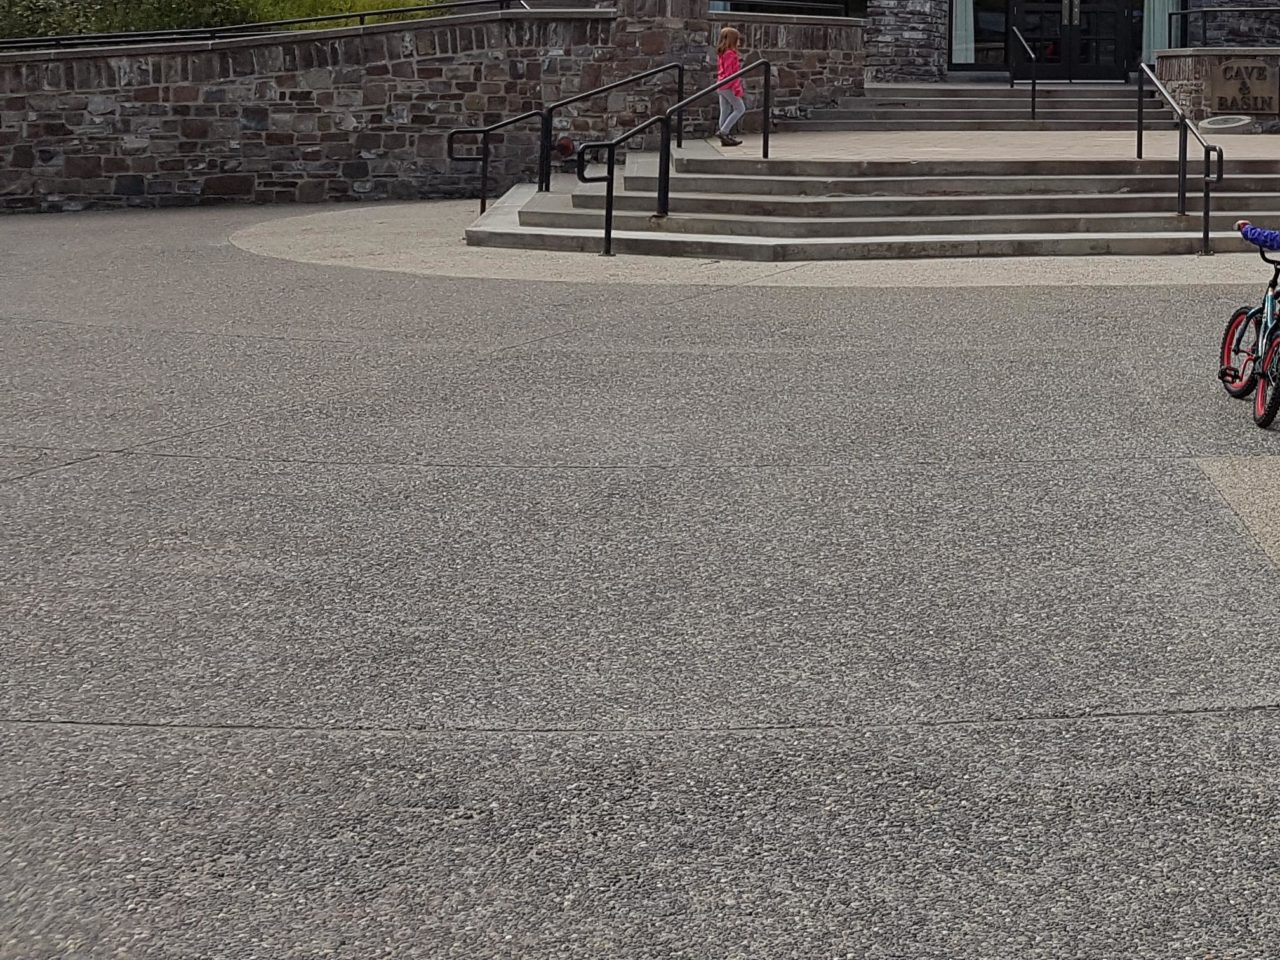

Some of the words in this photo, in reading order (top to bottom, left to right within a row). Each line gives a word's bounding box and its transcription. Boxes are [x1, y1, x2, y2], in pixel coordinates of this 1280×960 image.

[1222, 66, 1267, 81] CAVE
[1238, 81, 1251, 95] &
[1217, 96, 1273, 111] BASIN
